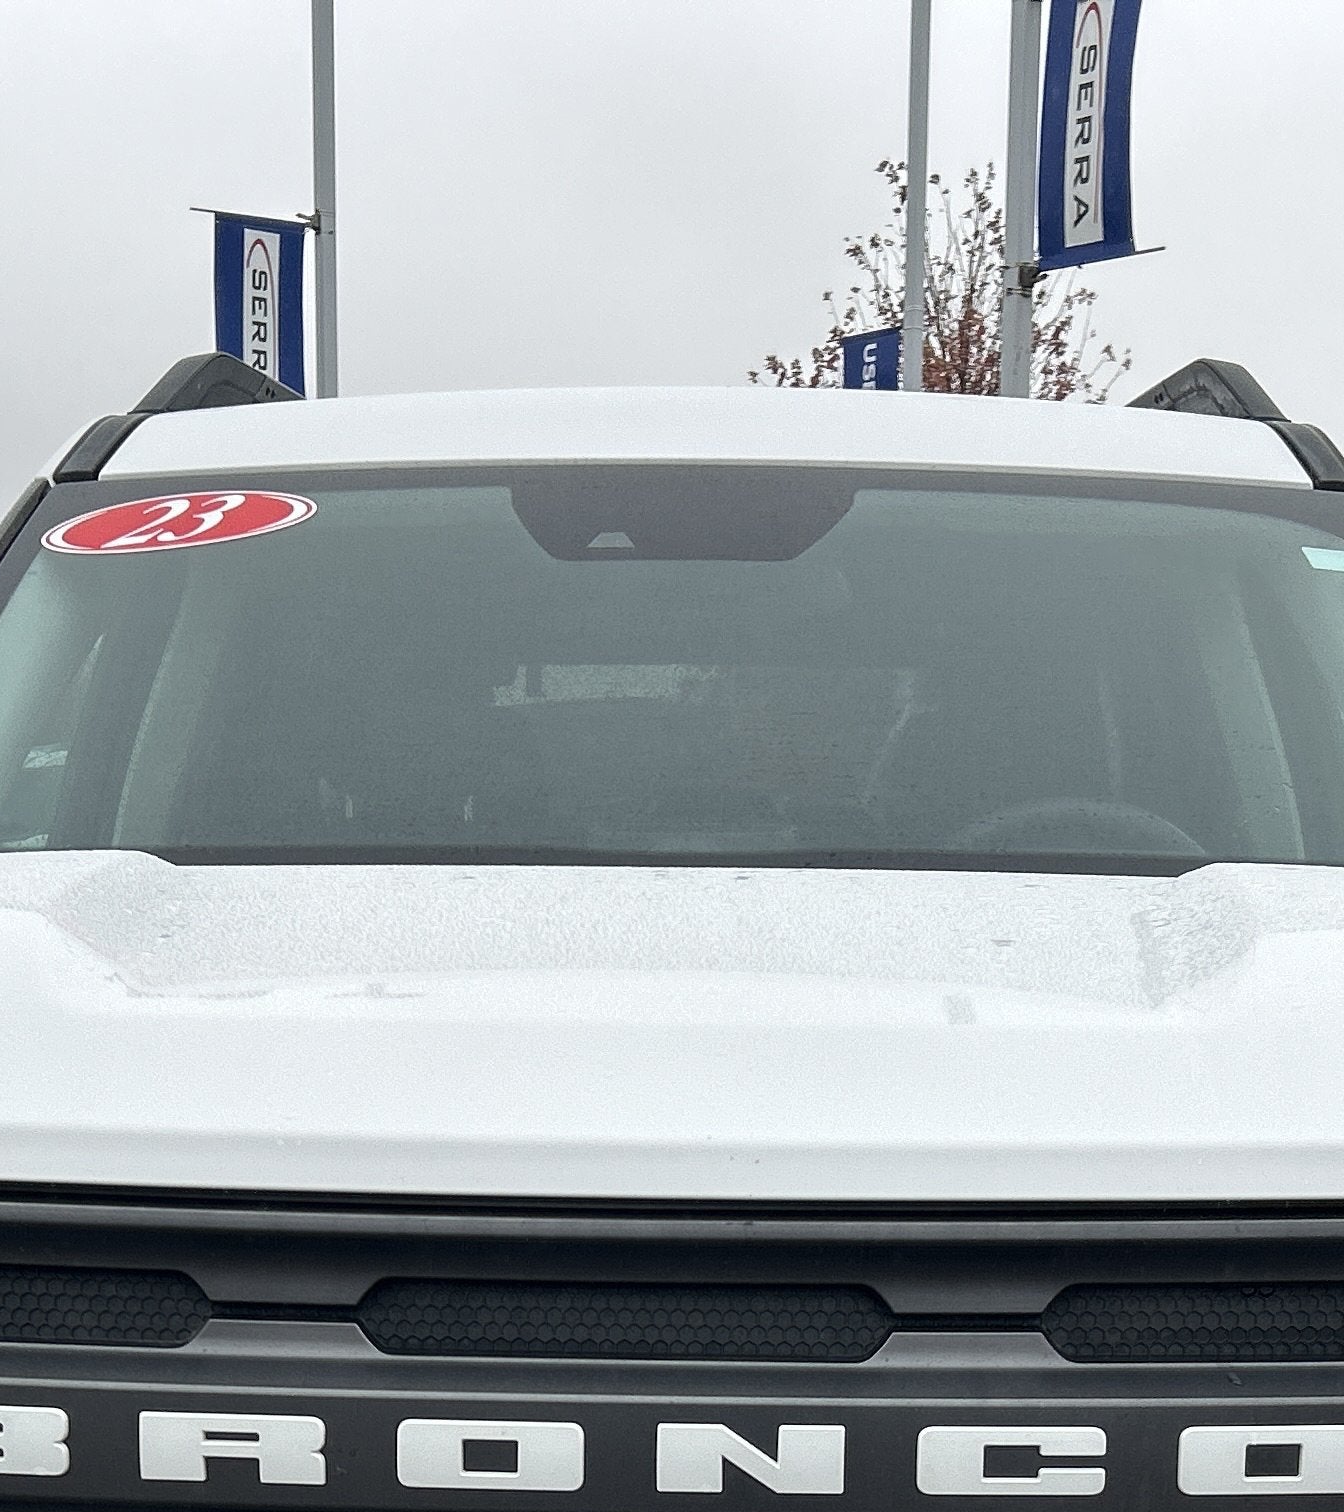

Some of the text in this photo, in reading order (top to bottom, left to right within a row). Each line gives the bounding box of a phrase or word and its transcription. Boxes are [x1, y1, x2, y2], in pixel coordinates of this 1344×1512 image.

[1073, 44, 1097, 228] SERRA
[251, 267, 269, 372] SERR
[862, 342, 877, 390] US
[99, 494, 246, 548] 23
